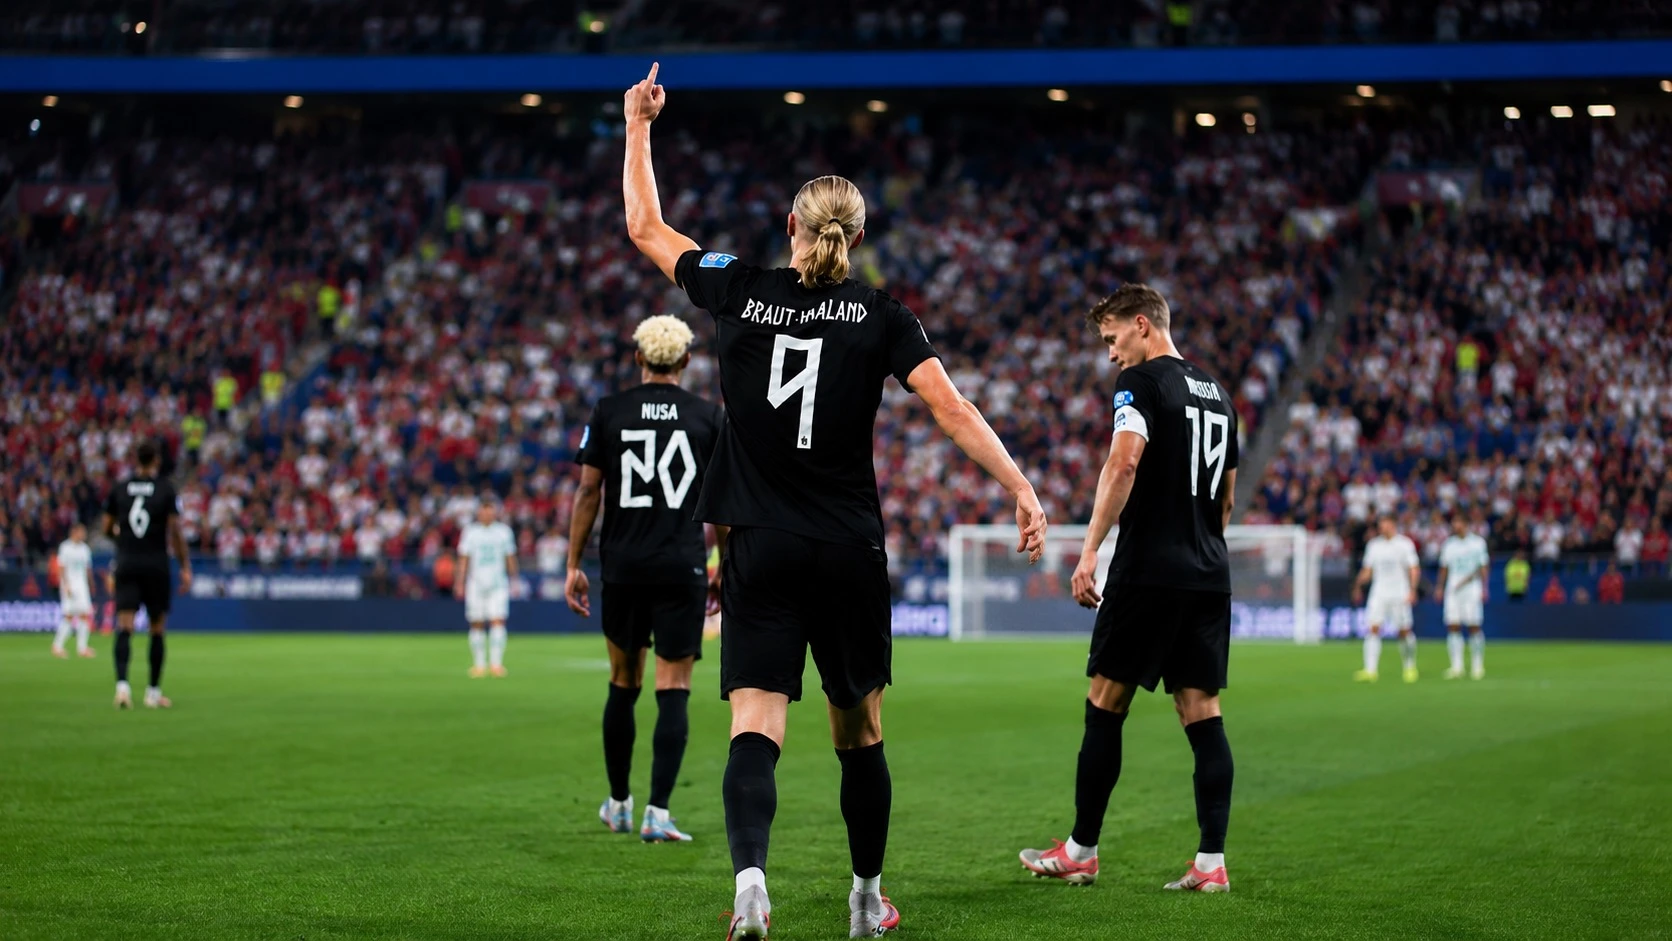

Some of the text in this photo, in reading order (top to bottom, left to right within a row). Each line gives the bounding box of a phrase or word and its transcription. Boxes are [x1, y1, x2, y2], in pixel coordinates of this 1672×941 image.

[641, 402, 679, 421] NUSA
[767, 334, 823, 449] 9
[620, 429, 697, 509] 20
[1185, 405, 1229, 500] 19
[128, 495, 151, 539] 6
